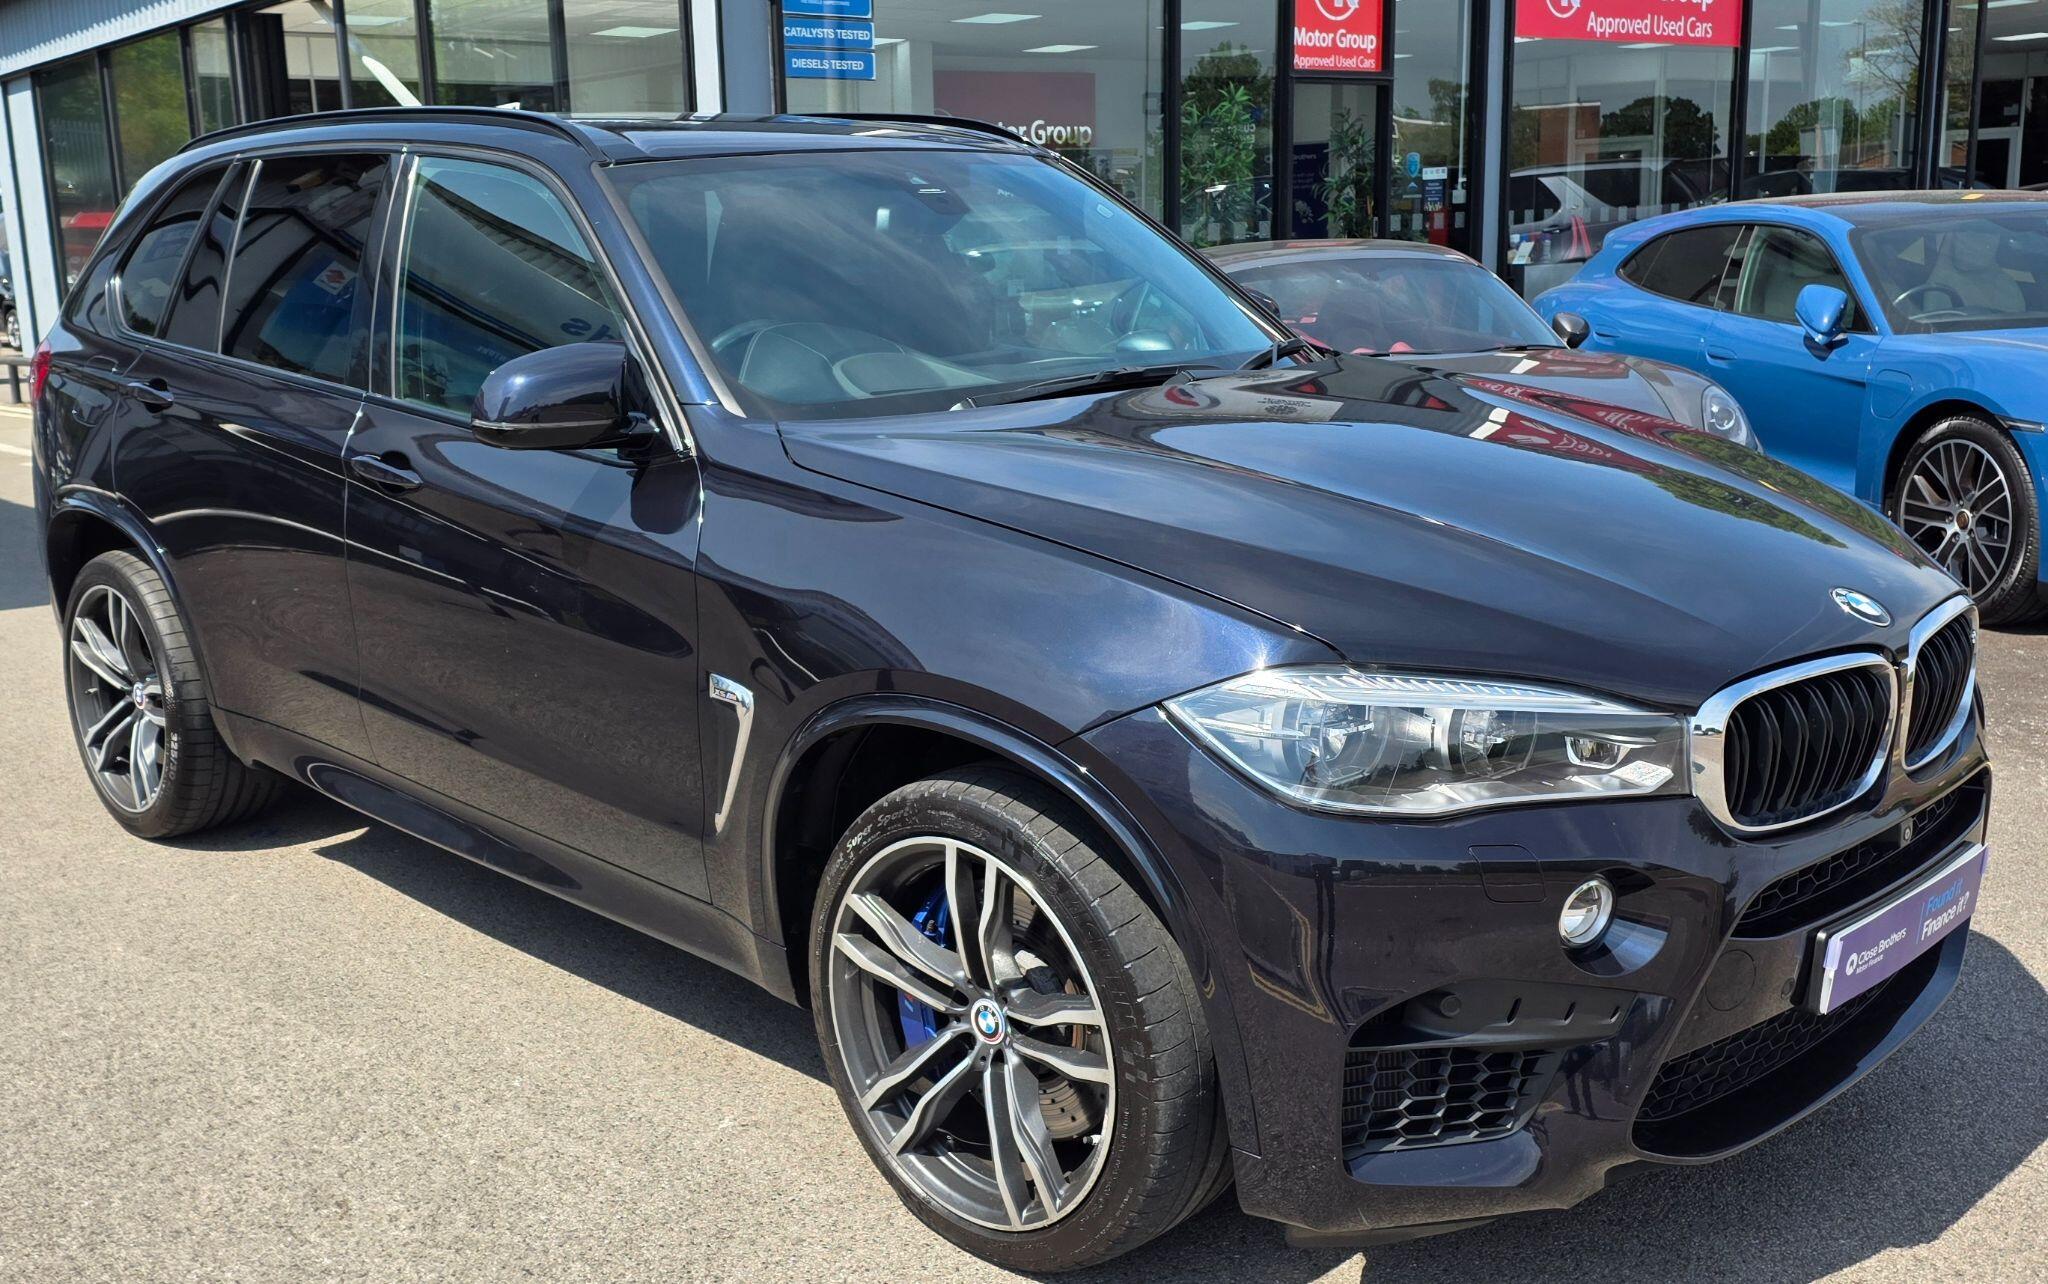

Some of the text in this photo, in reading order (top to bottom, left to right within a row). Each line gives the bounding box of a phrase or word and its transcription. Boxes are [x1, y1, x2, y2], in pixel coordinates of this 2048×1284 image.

[783, 26, 870, 40] CATALYSTS TESTED
[1586, 11, 1713, 38] Approved Used Cars
[1293, 26, 1377, 53] Motor Group
[792, 58, 864, 70] DIESELS TESTED
[1293, 54, 1376, 68] Approved Used Cars
[1030, 119, 1092, 147] Group
[846, 823, 874, 854] Super
[1925, 880, 1957, 917] Found
[1921, 904, 1957, 941] Finance
[1858, 929, 1907, 965] Close Brothers
